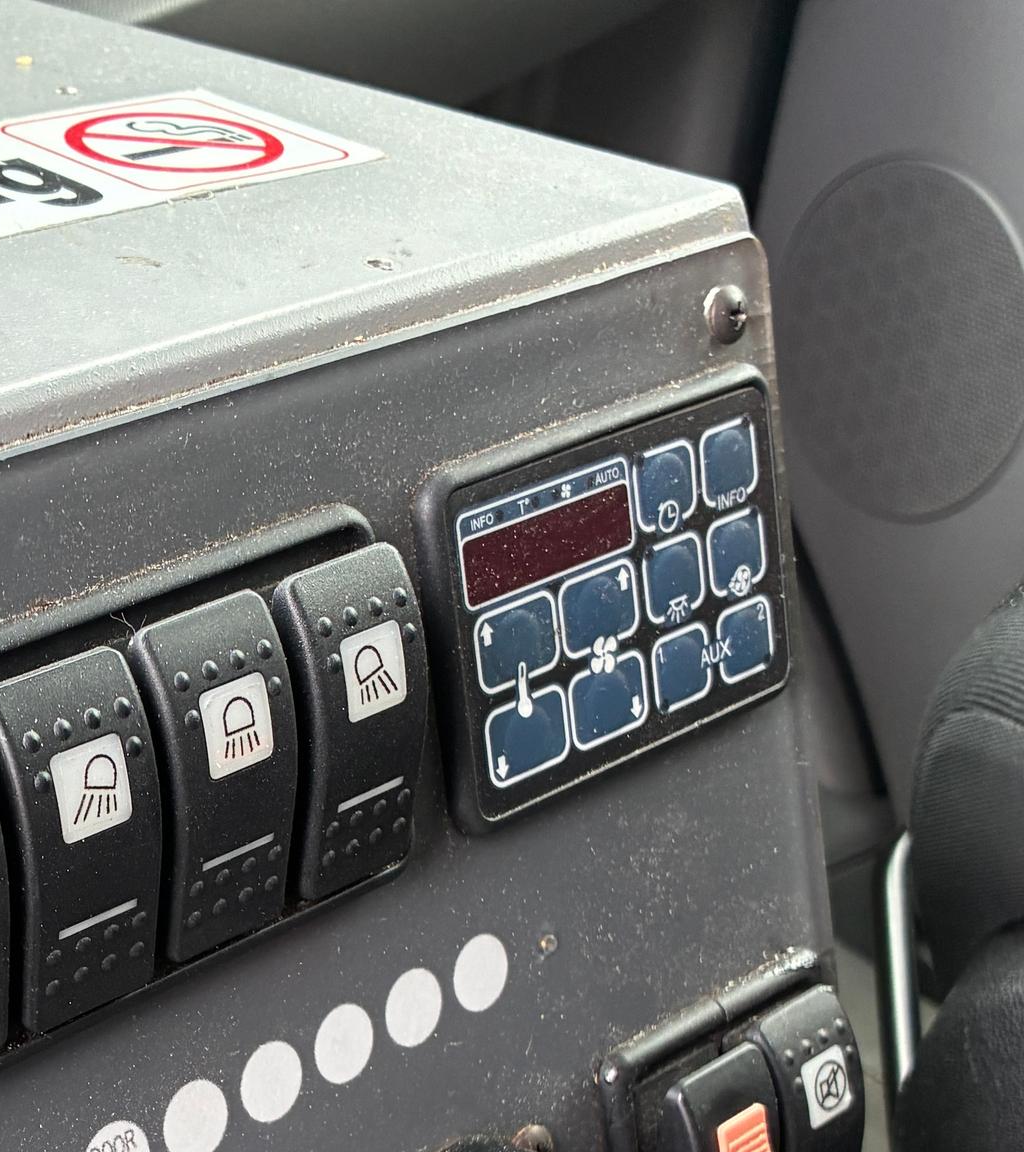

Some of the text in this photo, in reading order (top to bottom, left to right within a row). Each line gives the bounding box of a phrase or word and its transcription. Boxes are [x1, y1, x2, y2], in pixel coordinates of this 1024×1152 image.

[470, 515, 494, 532] INFO
[594, 467, 620, 485] AUTO
[716, 488, 746, 510] INFO
[756, 605, 765, 619] 2
[656, 647, 664, 662] 1
[700, 639, 733, 668] AUX
